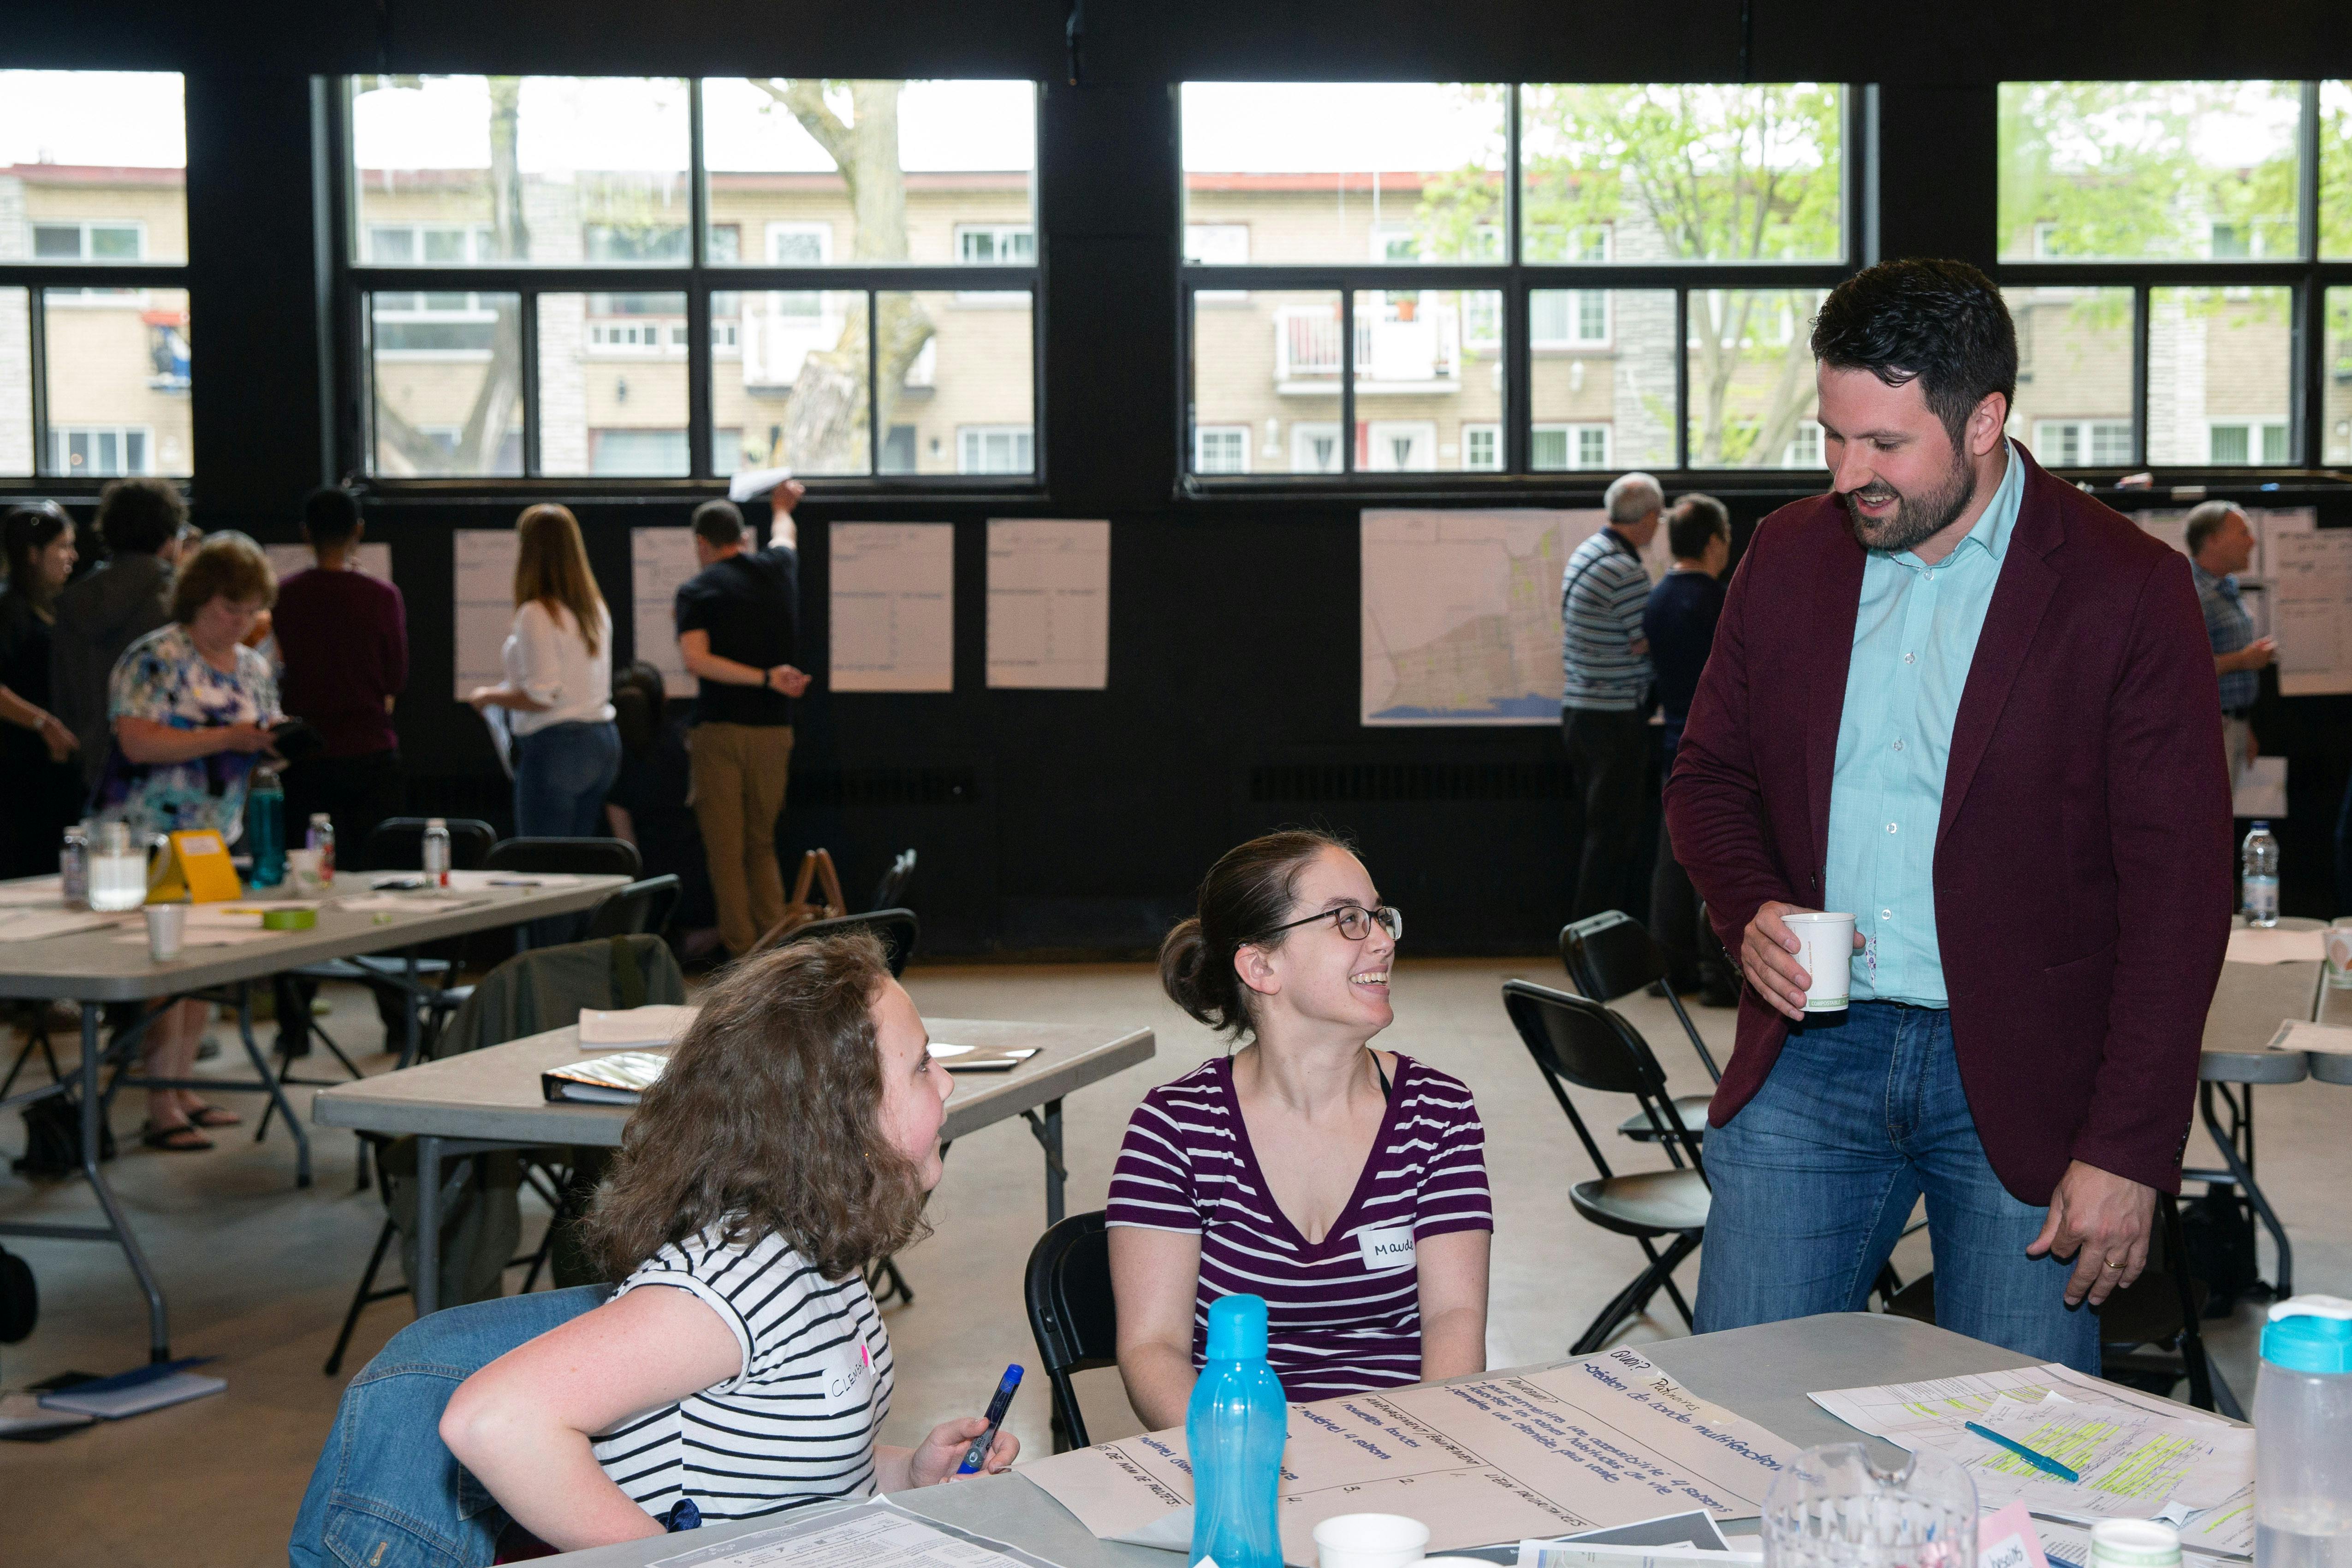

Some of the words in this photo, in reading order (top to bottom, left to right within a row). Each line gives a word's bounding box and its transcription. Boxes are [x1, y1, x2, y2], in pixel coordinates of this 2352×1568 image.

[1375, 1239, 1414, 1256] Maude
[1649, 1378, 1701, 1412] Patinoires
[1299, 1410, 1348, 1433] matériel
[1626, 1392, 1650, 1402] de
[1647, 1401, 1693, 1425] bande
[1692, 1424, 1784, 1471] multifonction
[975, 1435, 984, 1448] BOLD
[1491, 1411, 1513, 1423] une
[1551, 1449, 1586, 1463] plus
[1585, 1463, 1620, 1484] vaste
[1513, 1409, 1531, 1418] les
[1530, 1417, 1566, 1436] saines
[1566, 1437, 1625, 1470] habitudes
[1623, 1470, 1646, 1481] de
[1647, 1480, 1673, 1496] vie
[1567, 1425, 1589, 1437] une
[1589, 1437, 1672, 1477] accessibilité
[1670, 1479, 1690, 1490] 4
[1116, 1462, 1139, 1474] NOM
